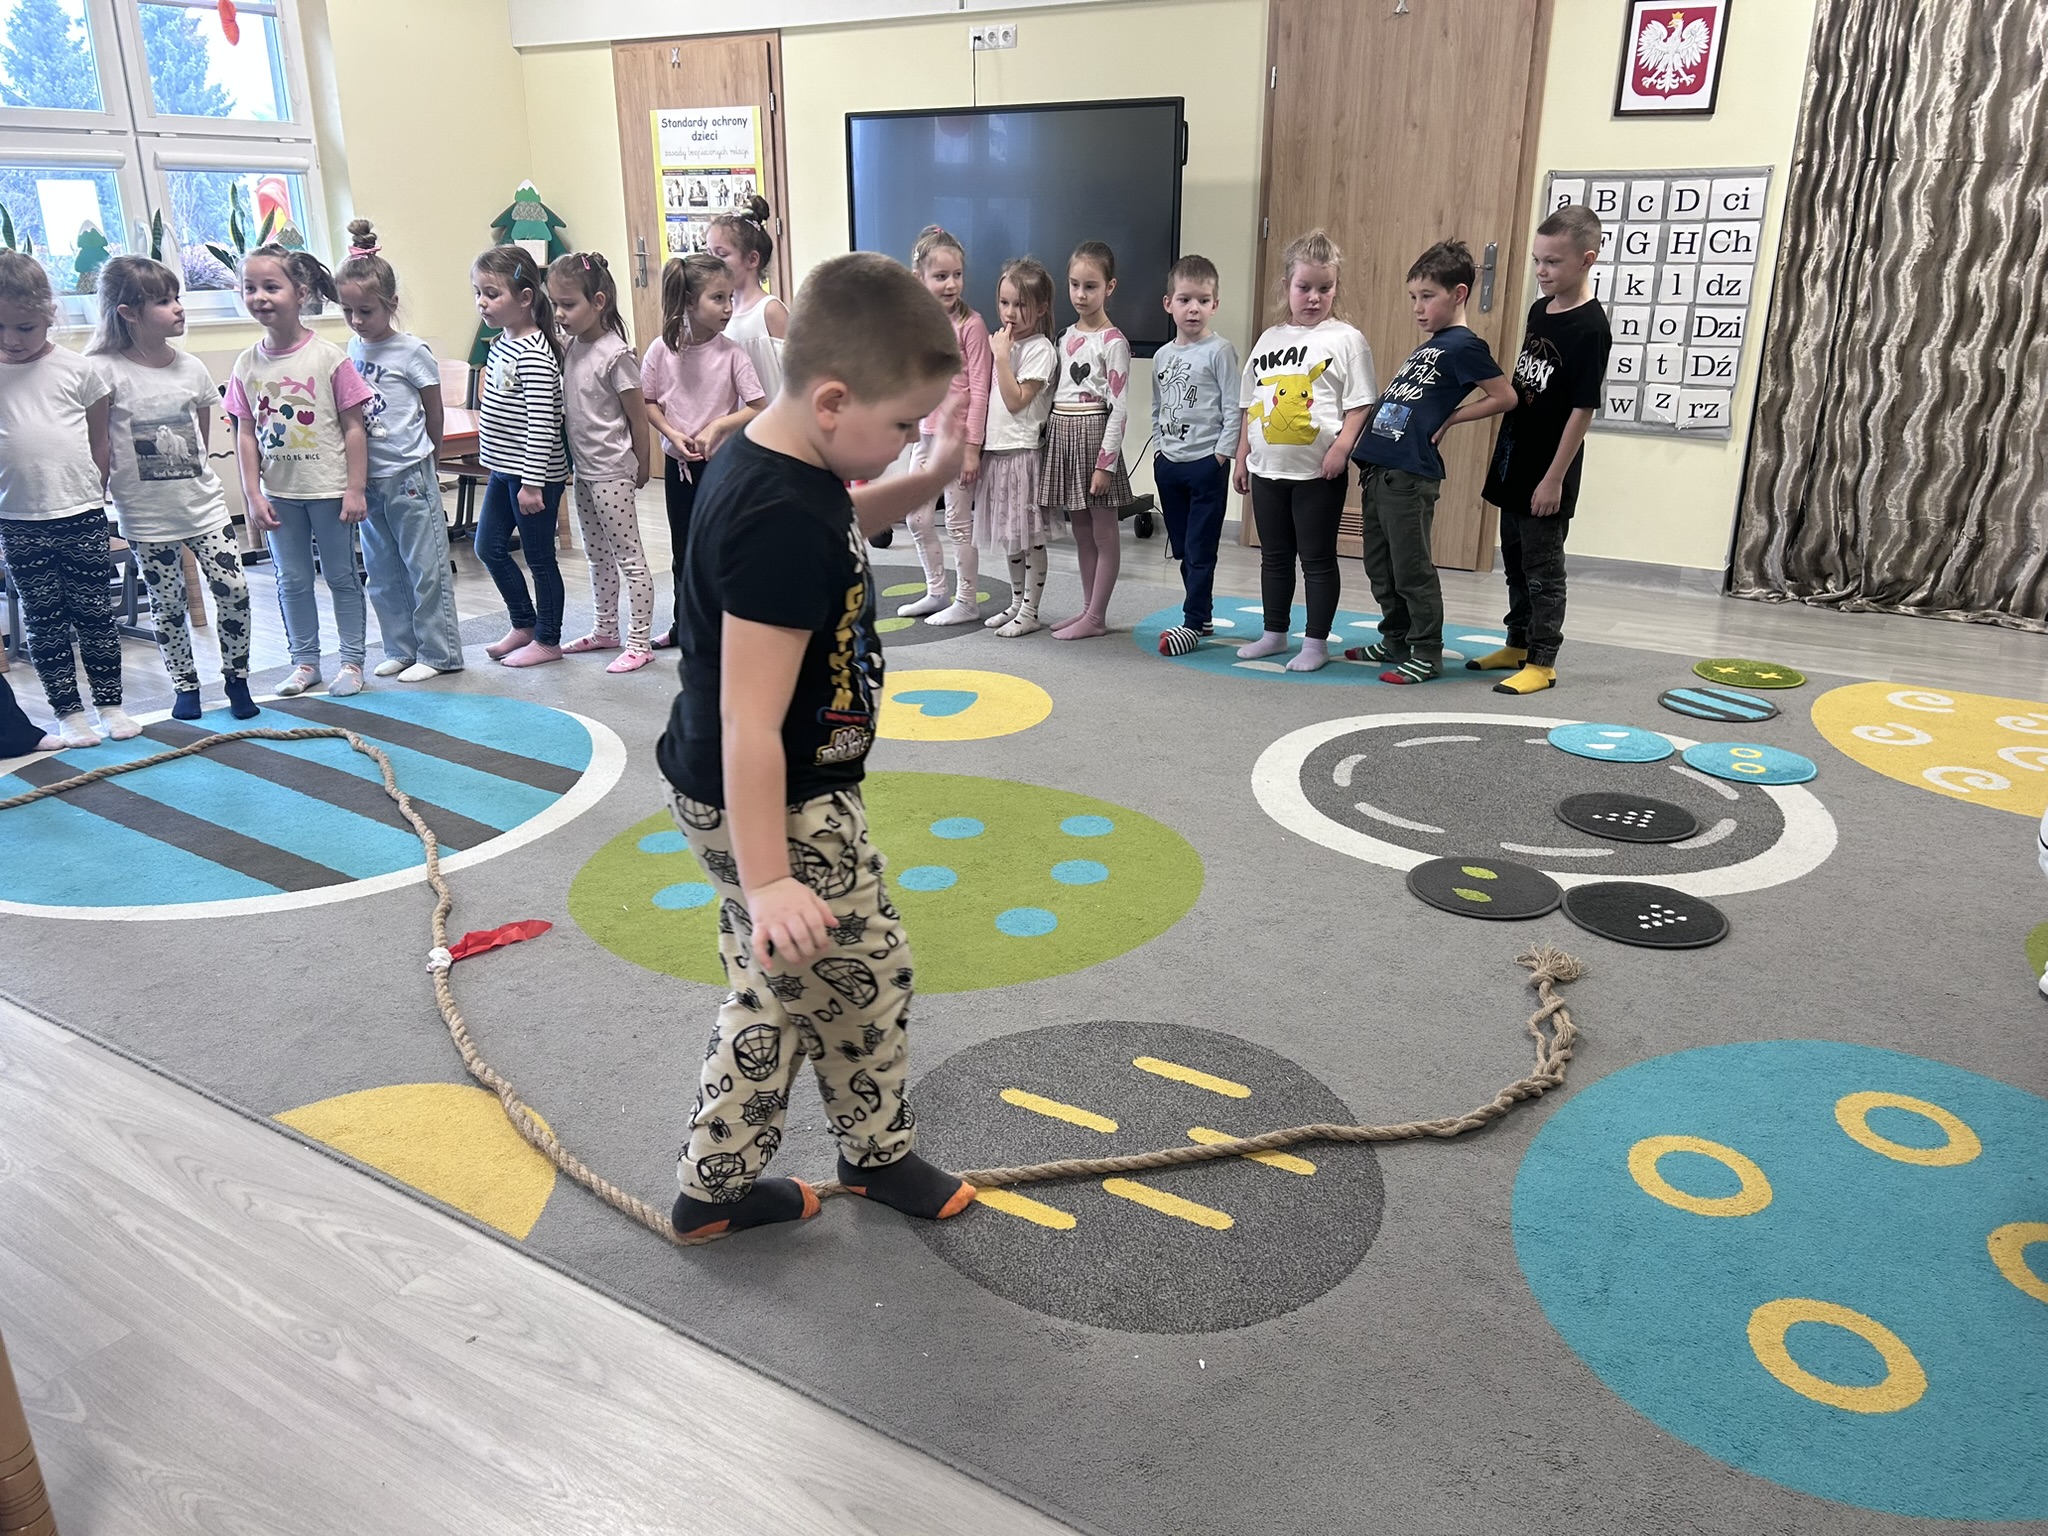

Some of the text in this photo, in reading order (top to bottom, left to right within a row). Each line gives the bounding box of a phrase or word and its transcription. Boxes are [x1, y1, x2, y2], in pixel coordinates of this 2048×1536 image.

[661, 115, 748, 129] Standardy ochrony
[691, 131, 718, 141] dzieci
[1595, 189, 1617, 212] B
[1637, 195, 1654, 212] c
[1674, 188, 1700, 212] D
[1723, 187, 1750, 210] ci
[1626, 231, 1650, 254] G
[1670, 232, 1700, 255] H
[1709, 230, 1752, 253] Ch
[1624, 273, 1645, 296] k
[1706, 273, 1742, 296] dz
[1620, 315, 1742, 338] n o Dzi
[1252, 345, 1308, 378] PIKA!
[1617, 354, 1732, 377] s t Dź
[1609, 393, 1720, 419] w z rz
[282, 453, 292, 461] TO
[293, 453, 302, 461] BE
[304, 452, 320, 461] NICE
